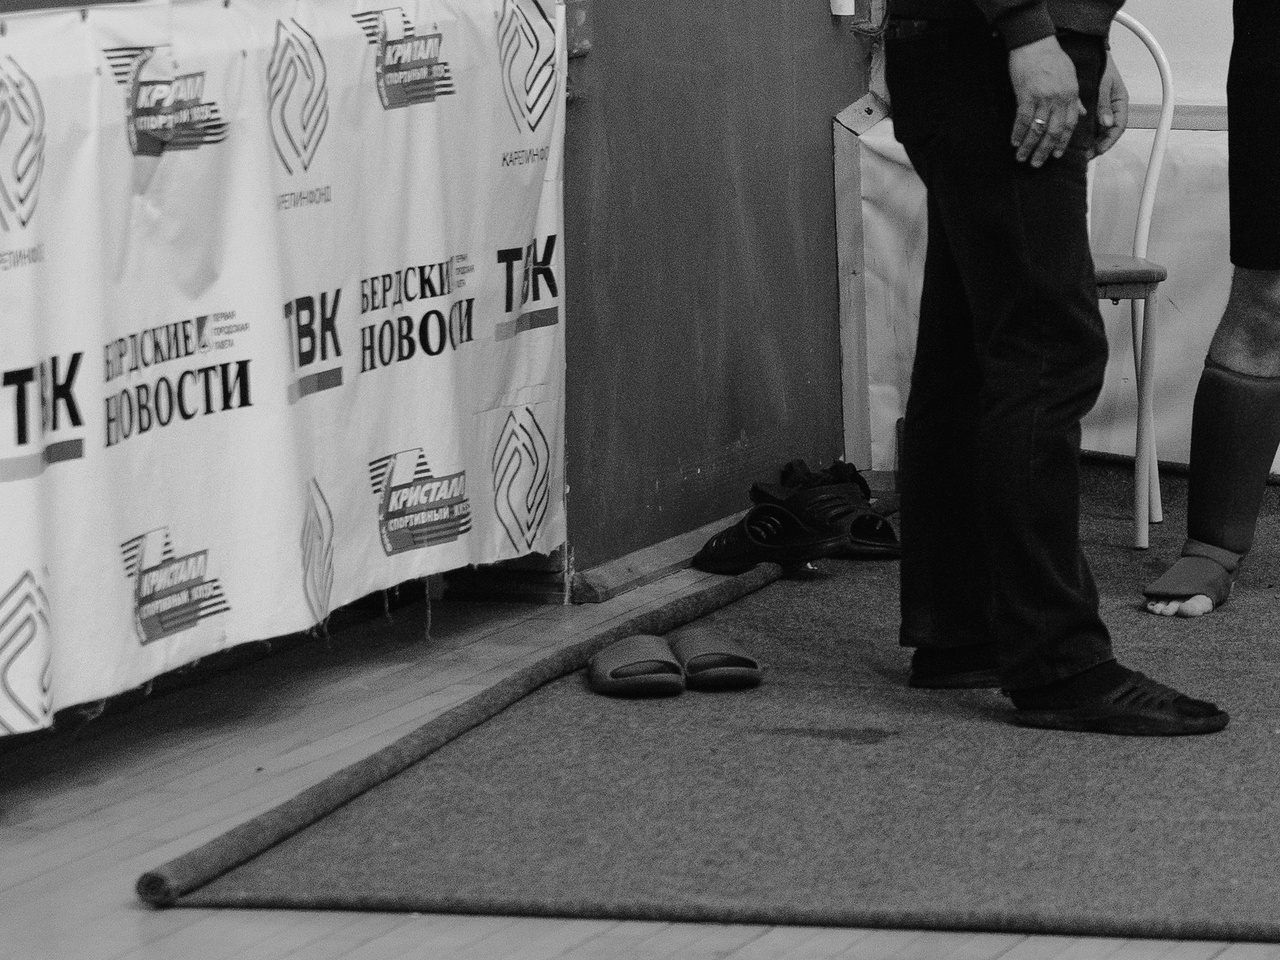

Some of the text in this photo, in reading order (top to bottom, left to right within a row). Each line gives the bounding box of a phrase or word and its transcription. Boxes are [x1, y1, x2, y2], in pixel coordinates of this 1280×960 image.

[360, 261, 452, 314] БЕРДСКИ
[3, 351, 84, 445] ТК
[104, 358, 253, 448] НОВОСТИ
